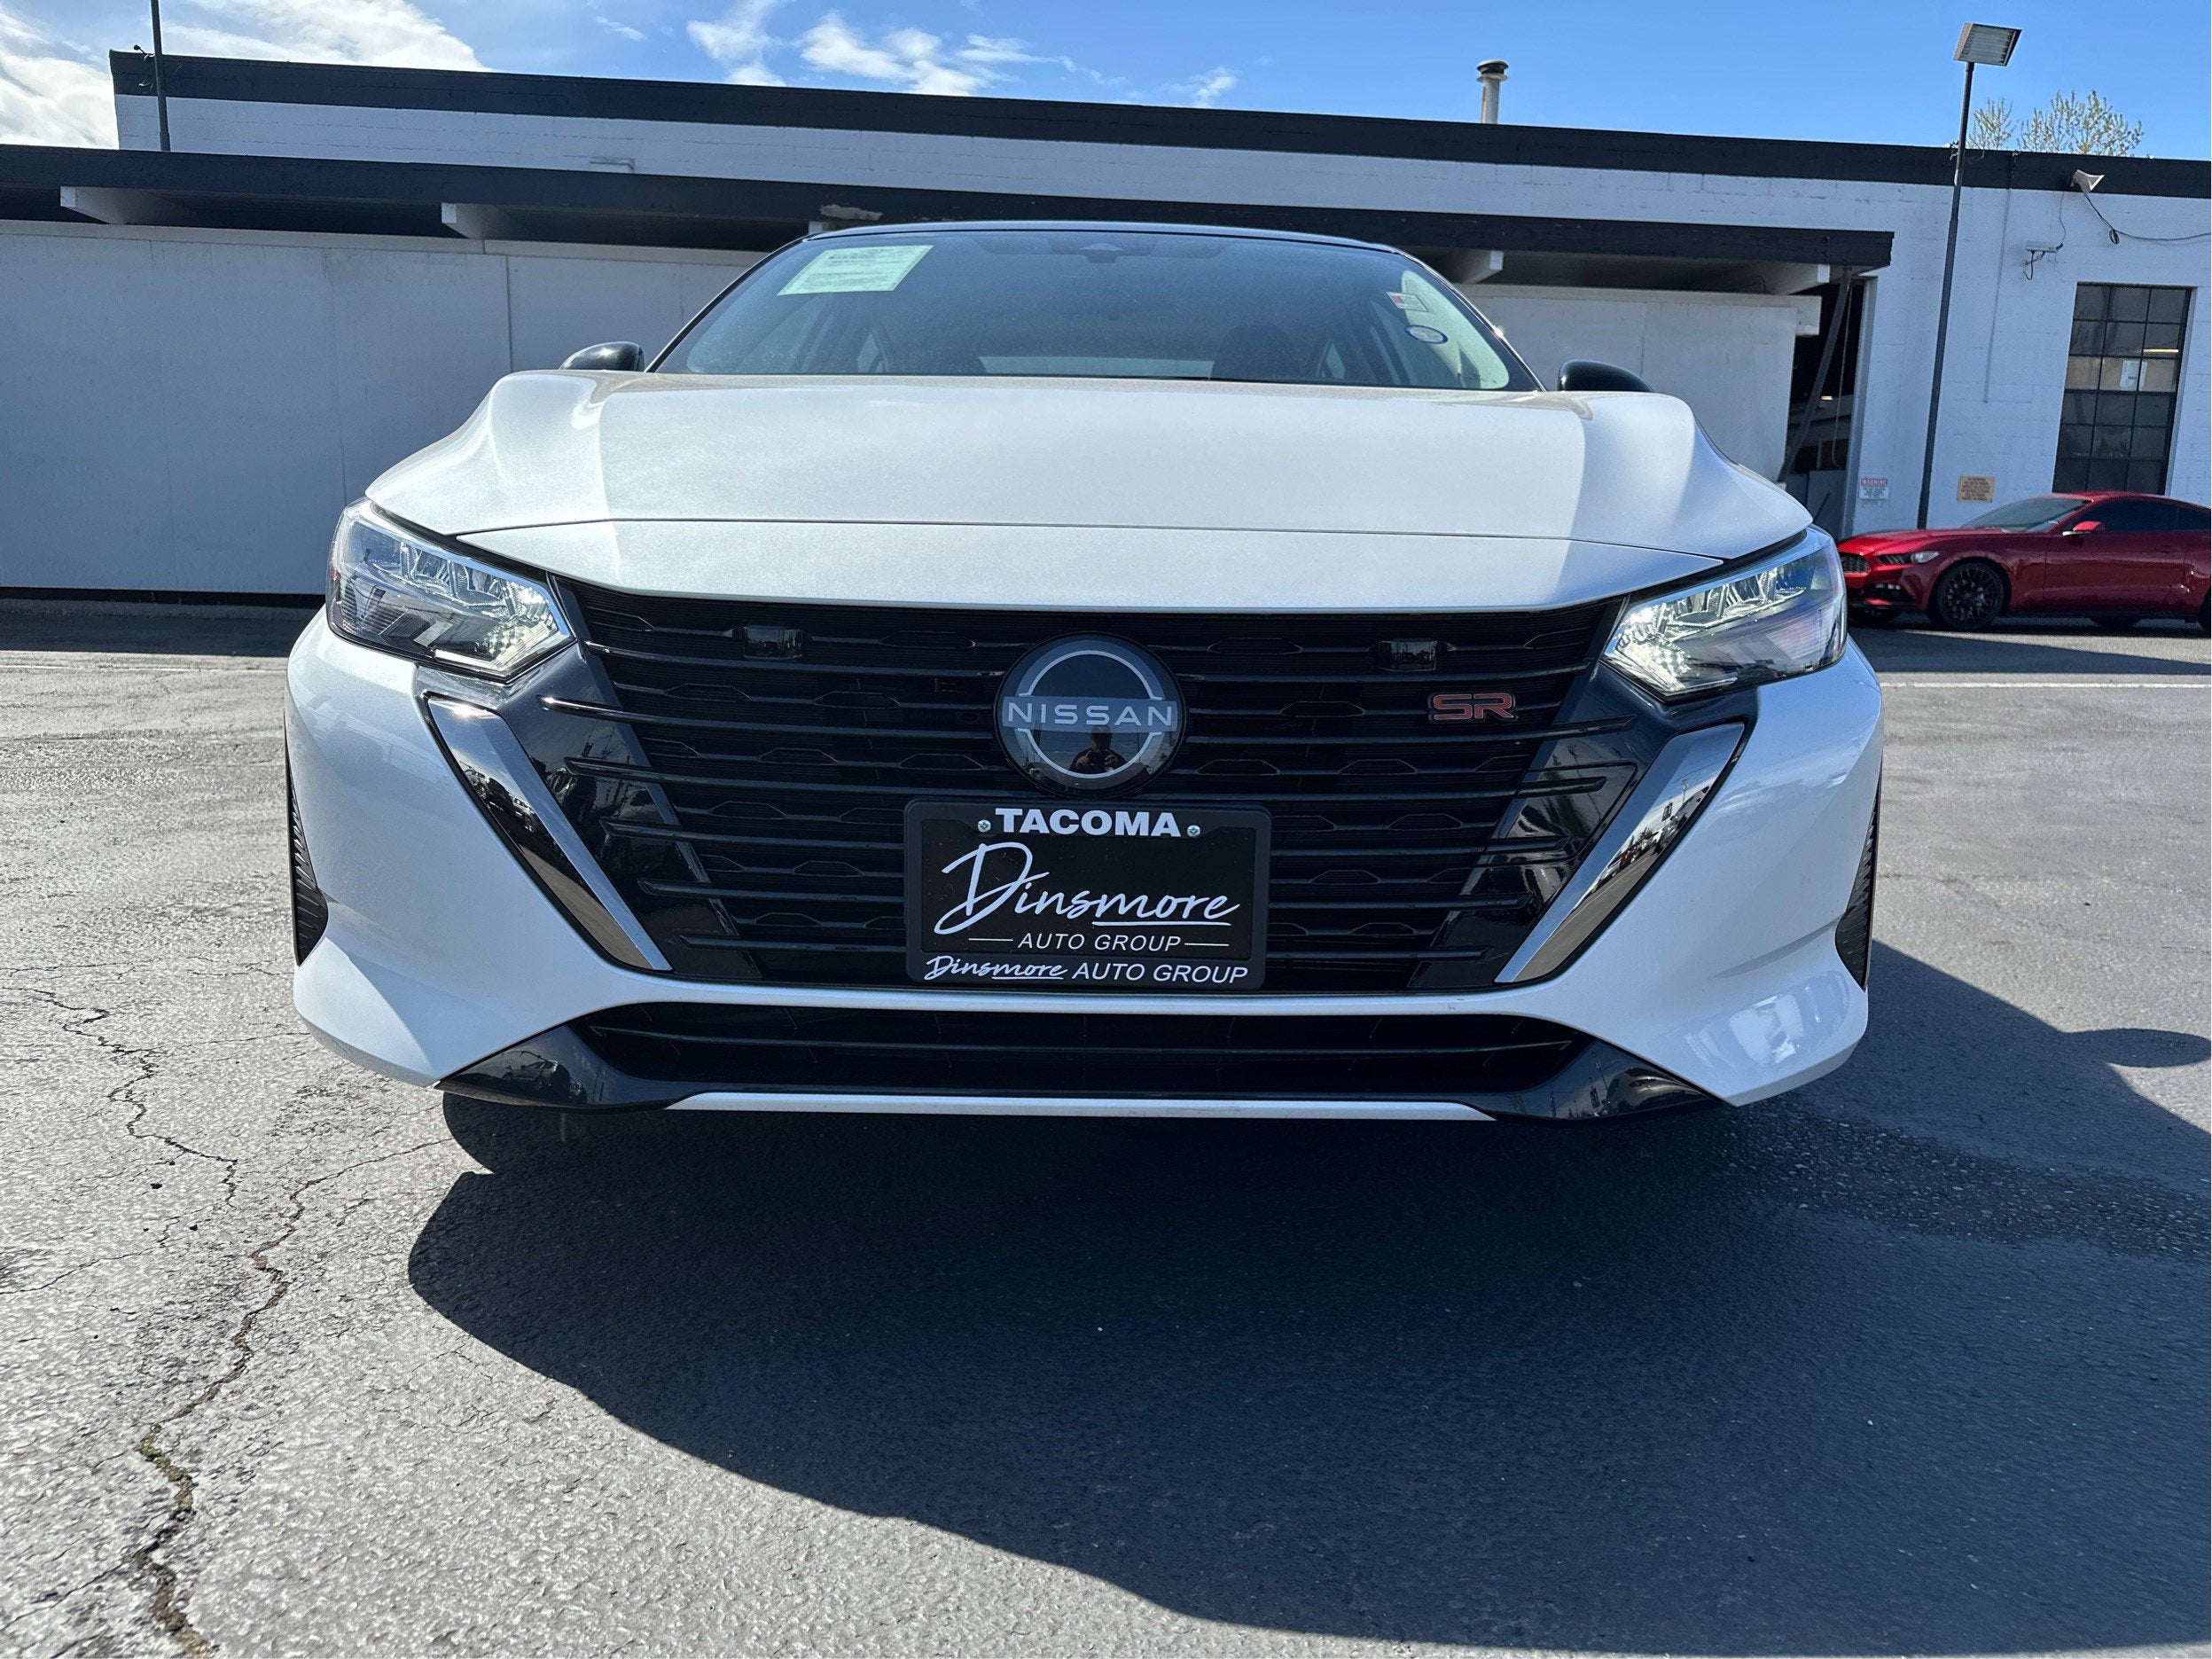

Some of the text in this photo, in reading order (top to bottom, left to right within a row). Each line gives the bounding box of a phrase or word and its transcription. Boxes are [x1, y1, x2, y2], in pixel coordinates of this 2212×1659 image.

[1008, 702, 1172, 726] NISSAN
[1433, 693, 1514, 720] SR
[995, 808, 1181, 837] TACOMA
[934, 842, 1239, 935] Dinsmore
[1018, 933, 1181, 951] AUTO GROUP
[924, 955, 1248, 984] Dinsmore AUTO GROUP
